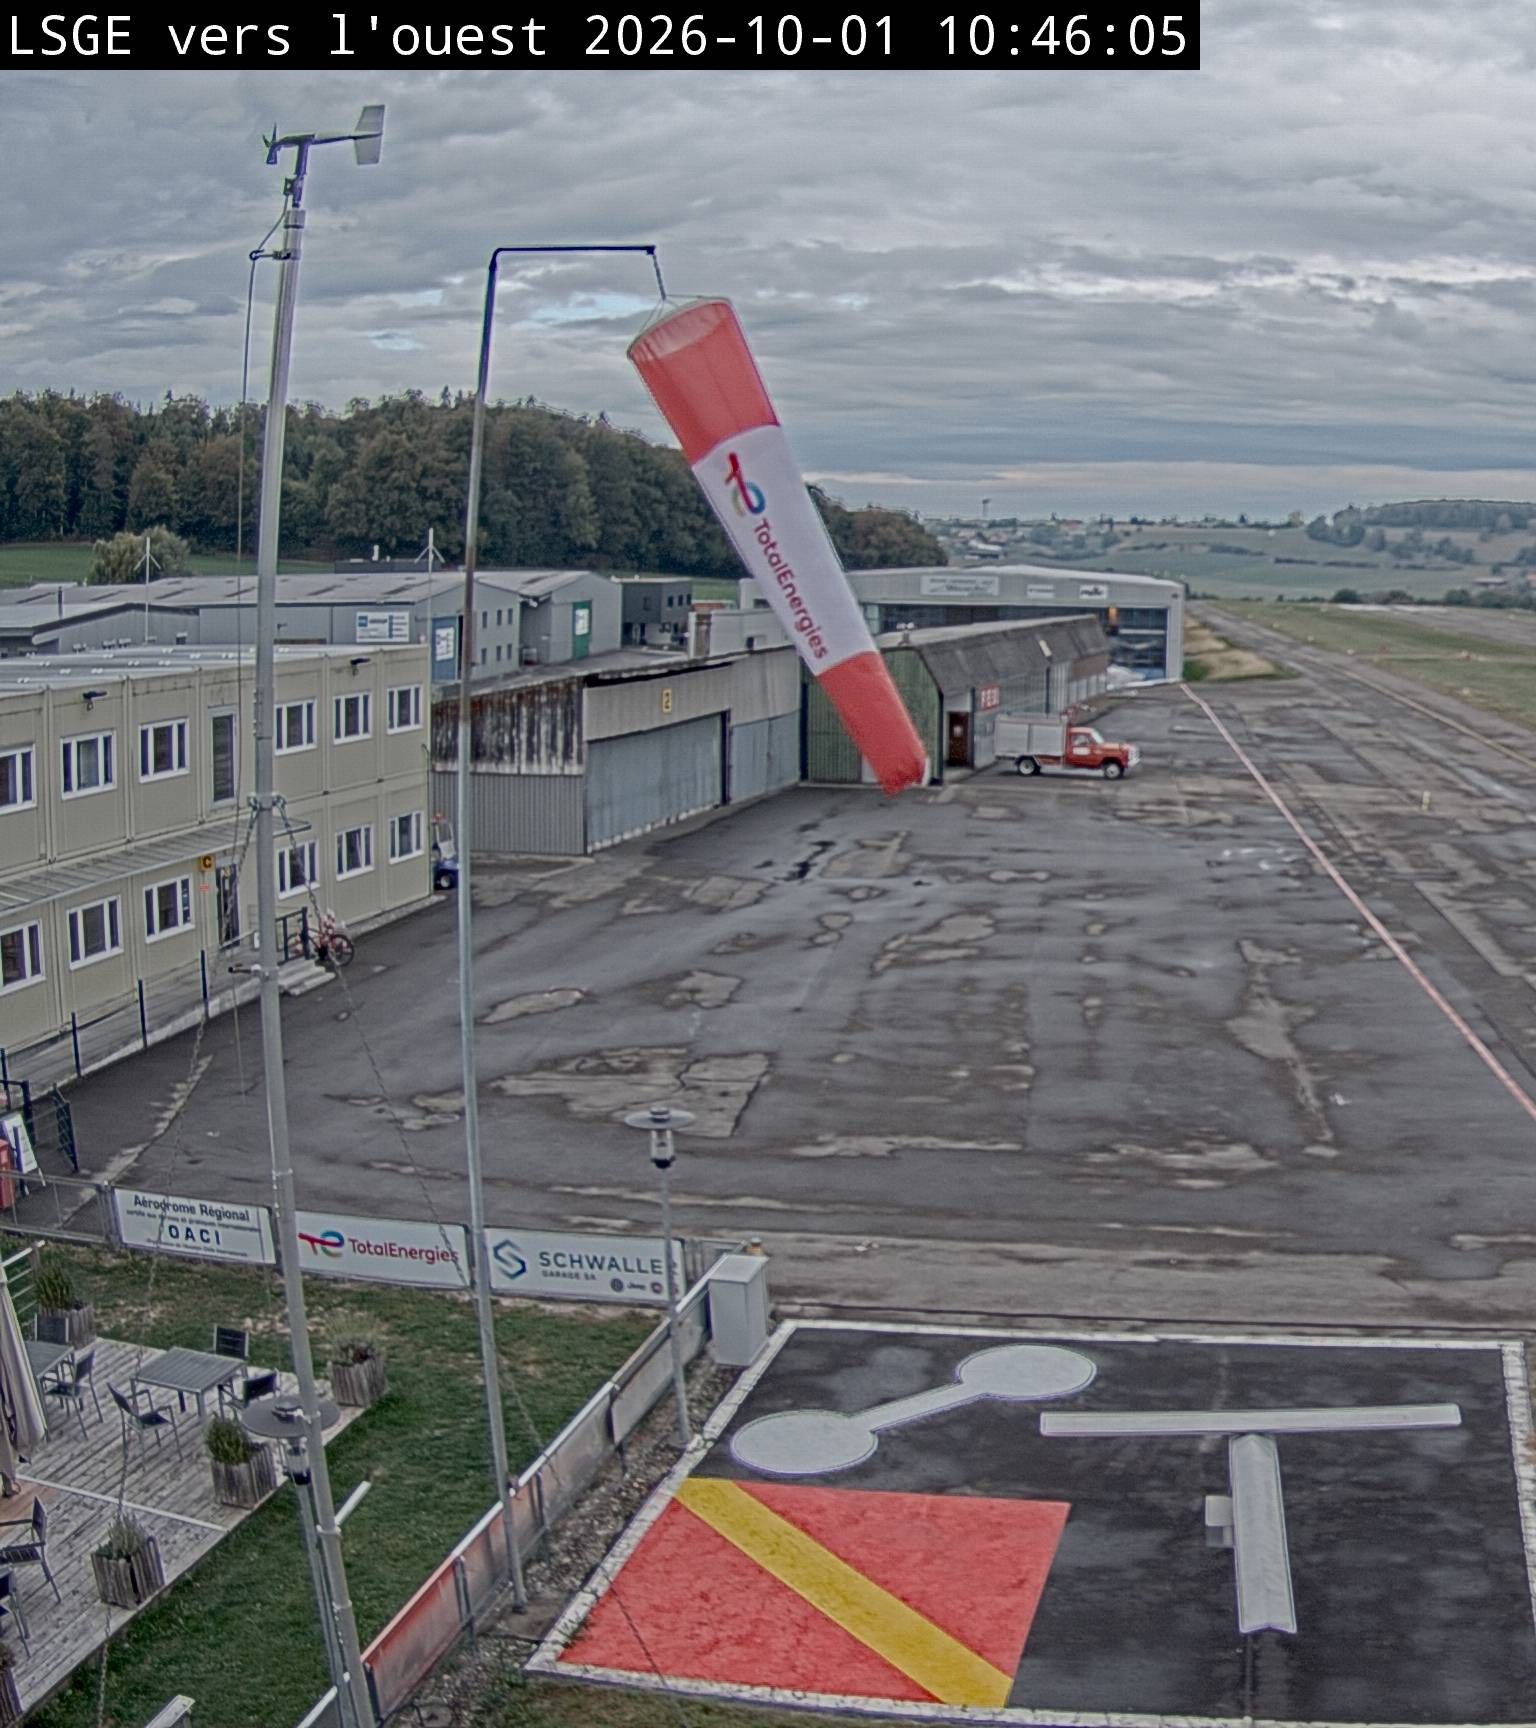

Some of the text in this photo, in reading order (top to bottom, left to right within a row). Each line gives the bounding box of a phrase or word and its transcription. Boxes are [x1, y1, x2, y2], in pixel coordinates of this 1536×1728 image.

[754, 518, 828, 659] TotalEnergies
[133, 1194, 197, 1214] Aérodrome
[199, 1203, 251, 1222] Régional
[168, 1224, 222, 1246] OACI
[348, 1238, 459, 1265] TotalEnergies
[539, 1251, 663, 1276] SCHWALLE
